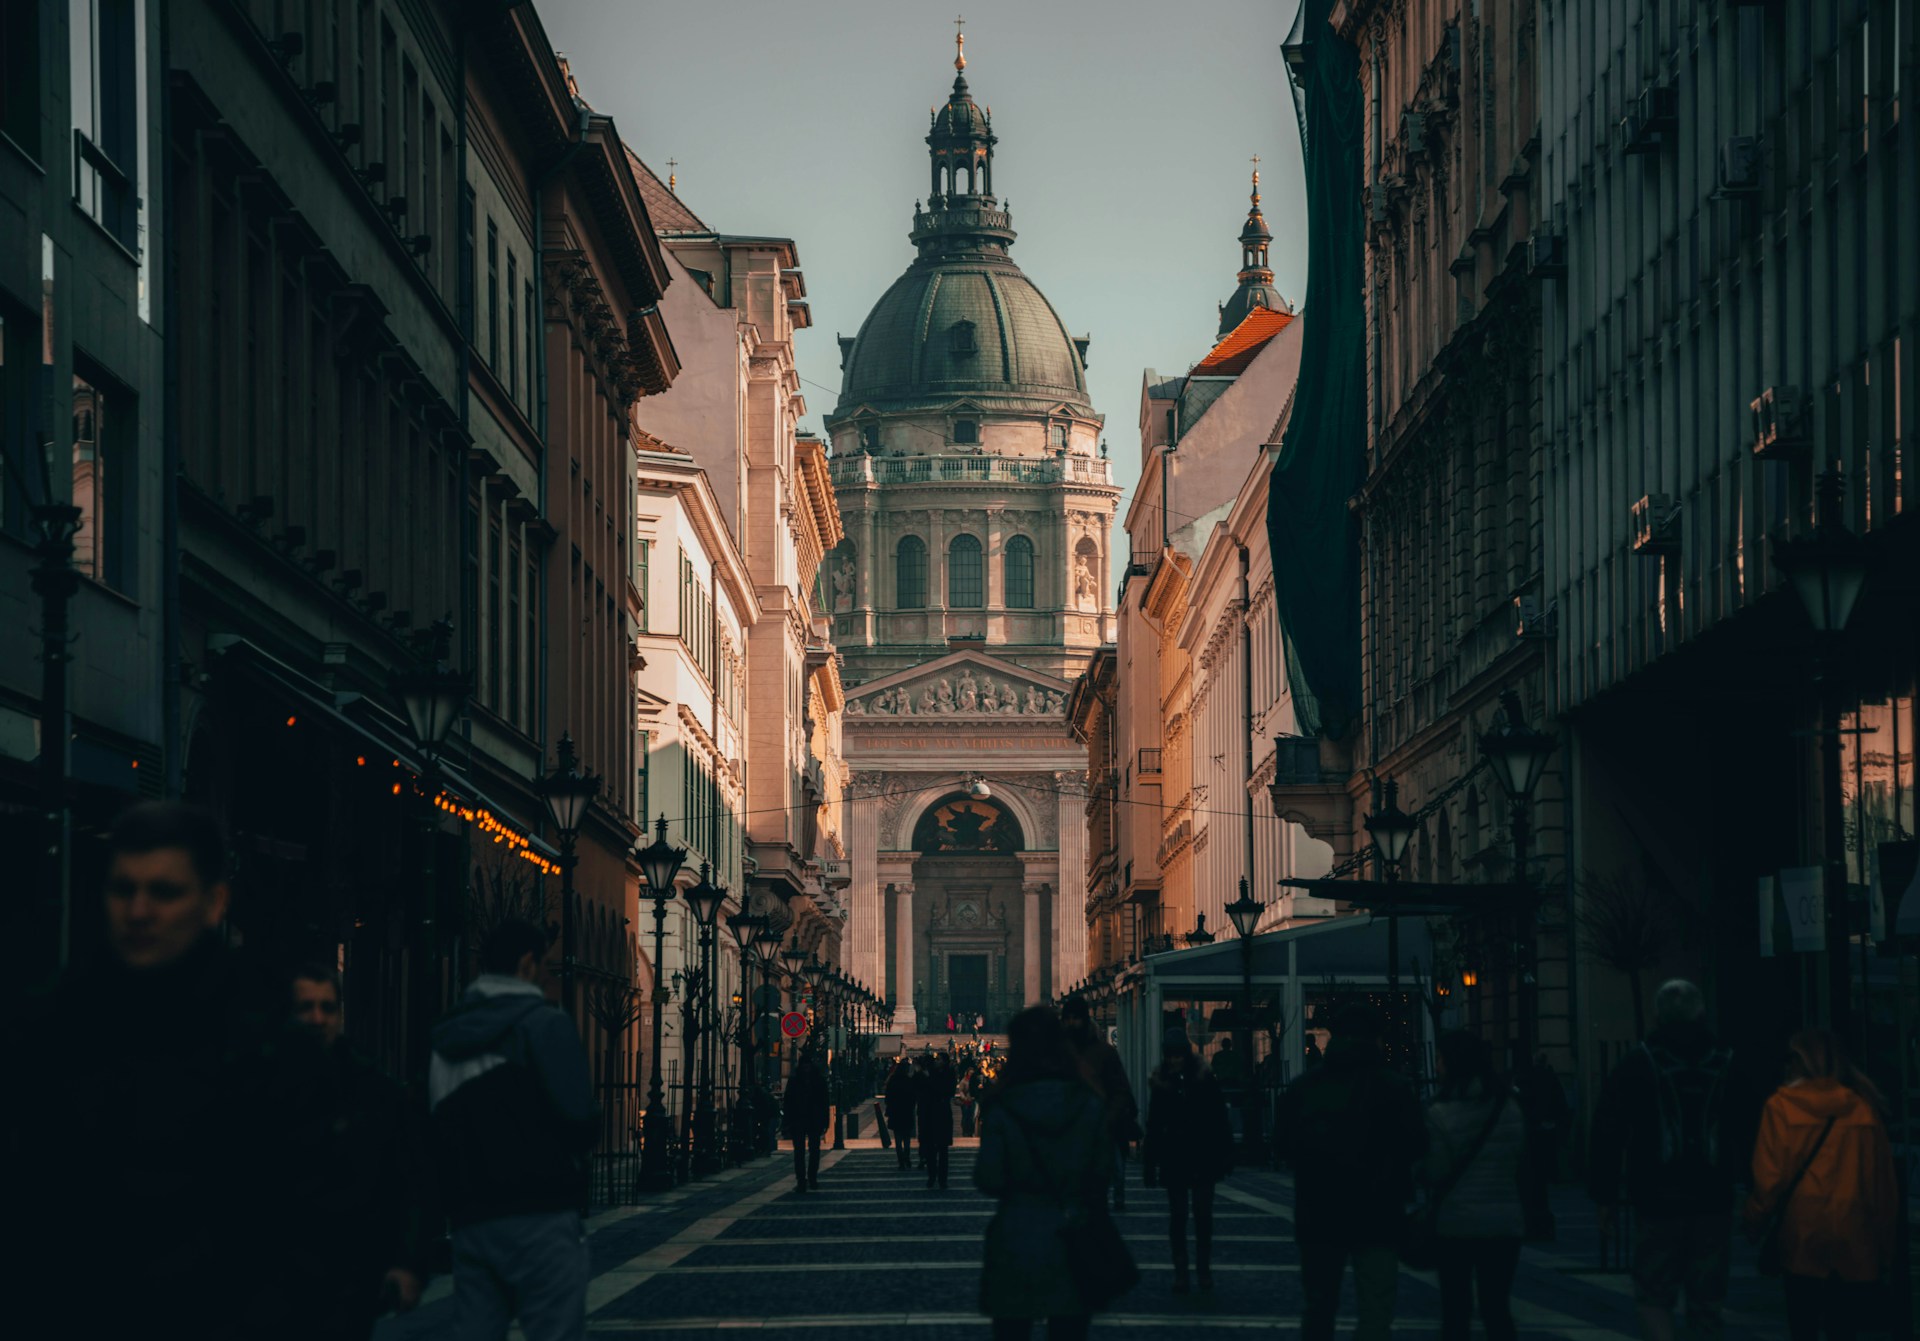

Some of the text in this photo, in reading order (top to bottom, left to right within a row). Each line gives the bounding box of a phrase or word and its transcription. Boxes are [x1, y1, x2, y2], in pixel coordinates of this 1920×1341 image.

[899, 738, 927, 749] SUM
[963, 738, 1014, 749] VERITAS
[1042, 738, 1070, 749] VITA
